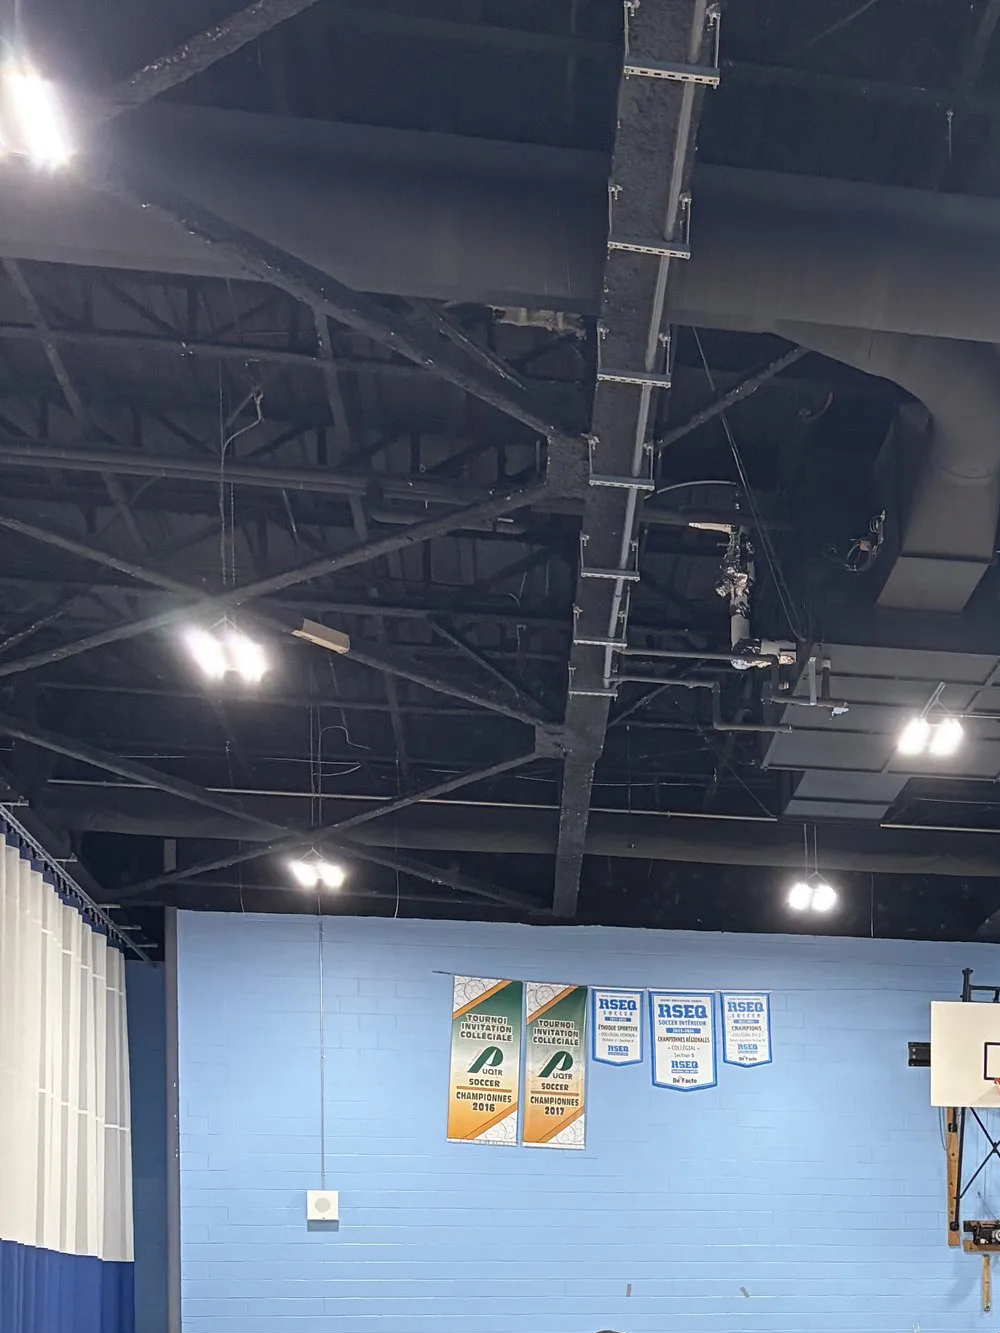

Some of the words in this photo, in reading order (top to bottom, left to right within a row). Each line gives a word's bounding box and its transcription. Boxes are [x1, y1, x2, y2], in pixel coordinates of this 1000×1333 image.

[598, 998, 638, 1010] RSEQ
[727, 1002, 764, 1012] RSEQ
[658, 1004, 708, 1018] RSEQ
[467, 1014, 507, 1024] TOURNOI
[539, 1020, 574, 1028] TOURNOI
[461, 1023, 512, 1033] INVITATION
[534, 1028, 579, 1038] INVITATION
[460, 1031, 512, 1042] COLLÉGIALE
[533, 1036, 579, 1046] COLLÉGIALE
[482, 1068, 503, 1076] UQTR
[553, 1072, 572, 1080] UQTR
[469, 1078, 500, 1087] SOCCER
[542, 1082, 569, 1091] SOCCER
[456, 1091, 512, 1102] CHAMPIONNES
[530, 1096, 579, 1106] CHAMPIONNES
[472, 1102, 495, 1112] 2016
[545, 1107, 564, 1115] 2017
